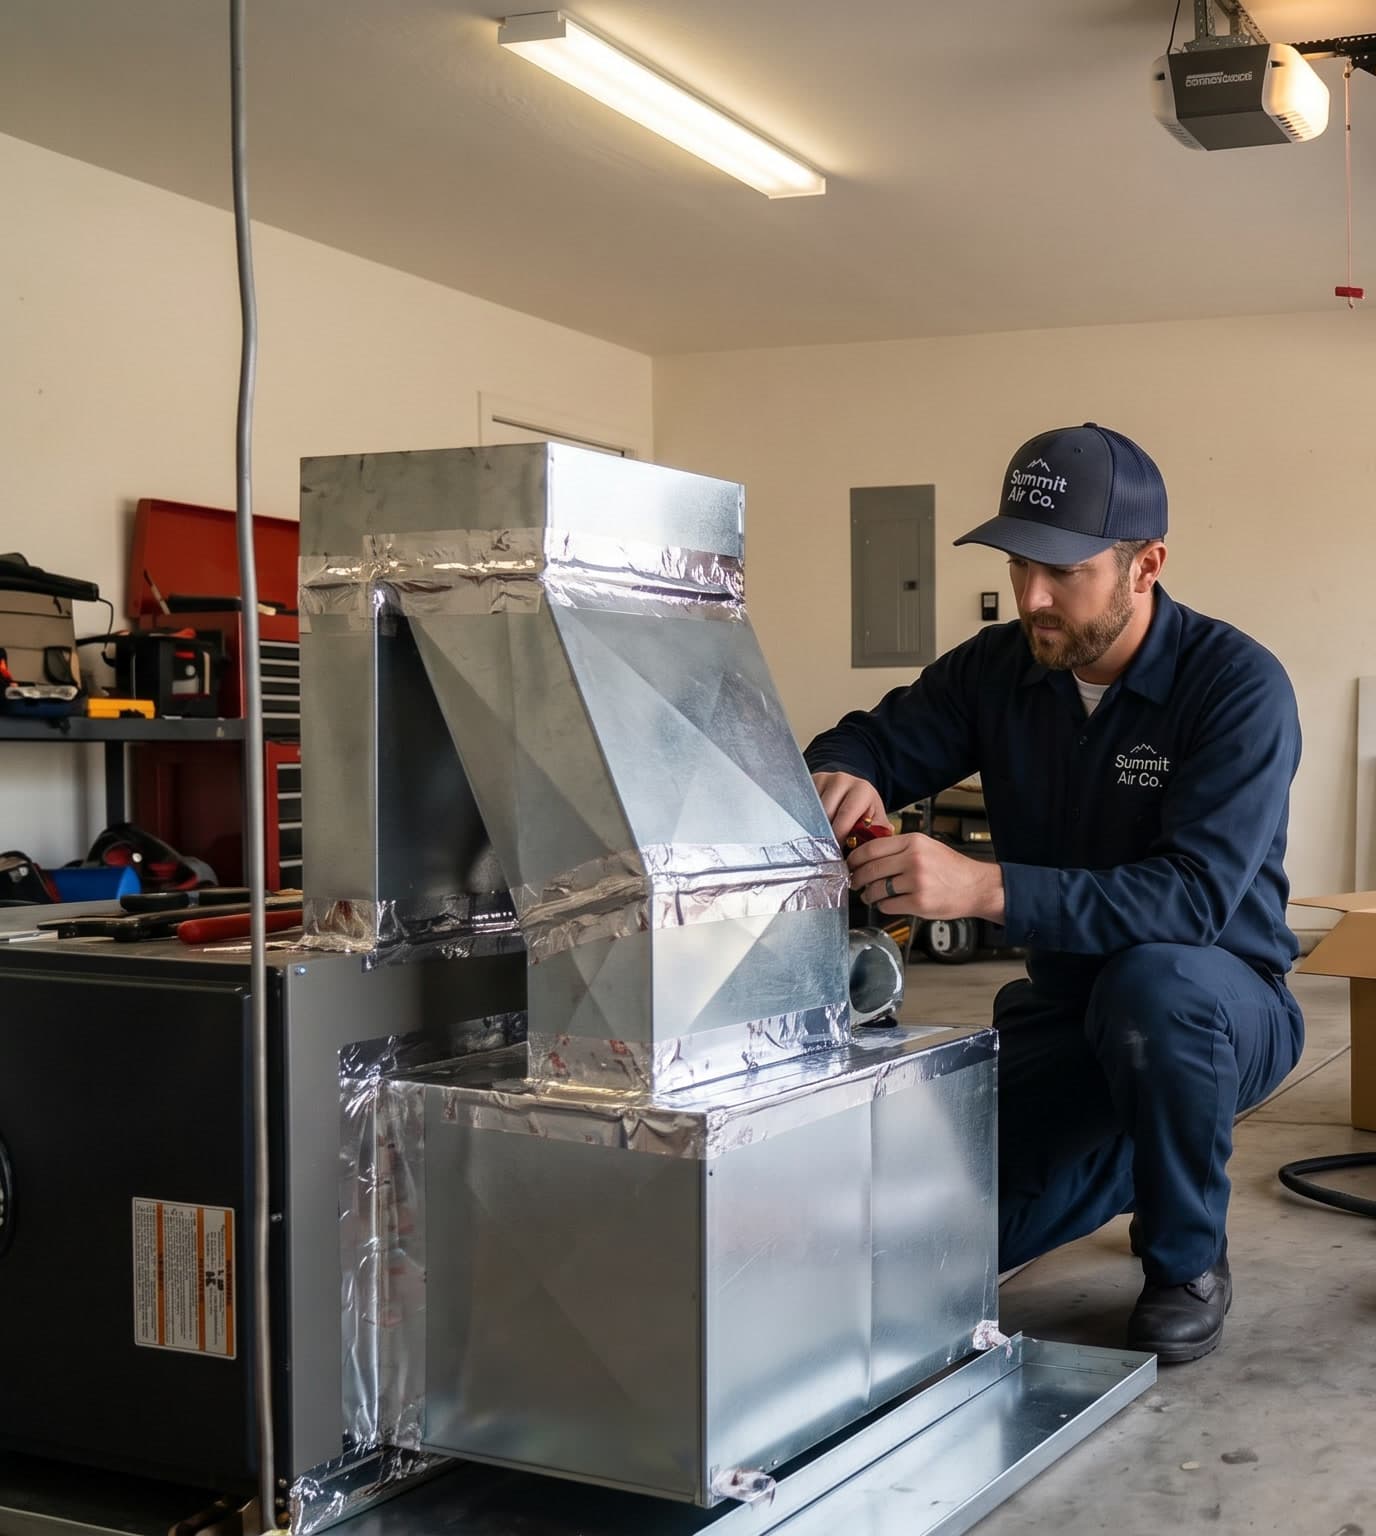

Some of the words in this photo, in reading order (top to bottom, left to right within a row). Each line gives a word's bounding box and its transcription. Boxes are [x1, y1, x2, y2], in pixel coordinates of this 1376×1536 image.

[1011, 469, 1068, 493] Summit
[1008, 486, 1026, 503] Air
[1029, 489, 1055, 509] Co.
[1114, 754, 1171, 772] Summit
[1117, 771, 1136, 785] Air
[1138, 772, 1163, 788] Co.
